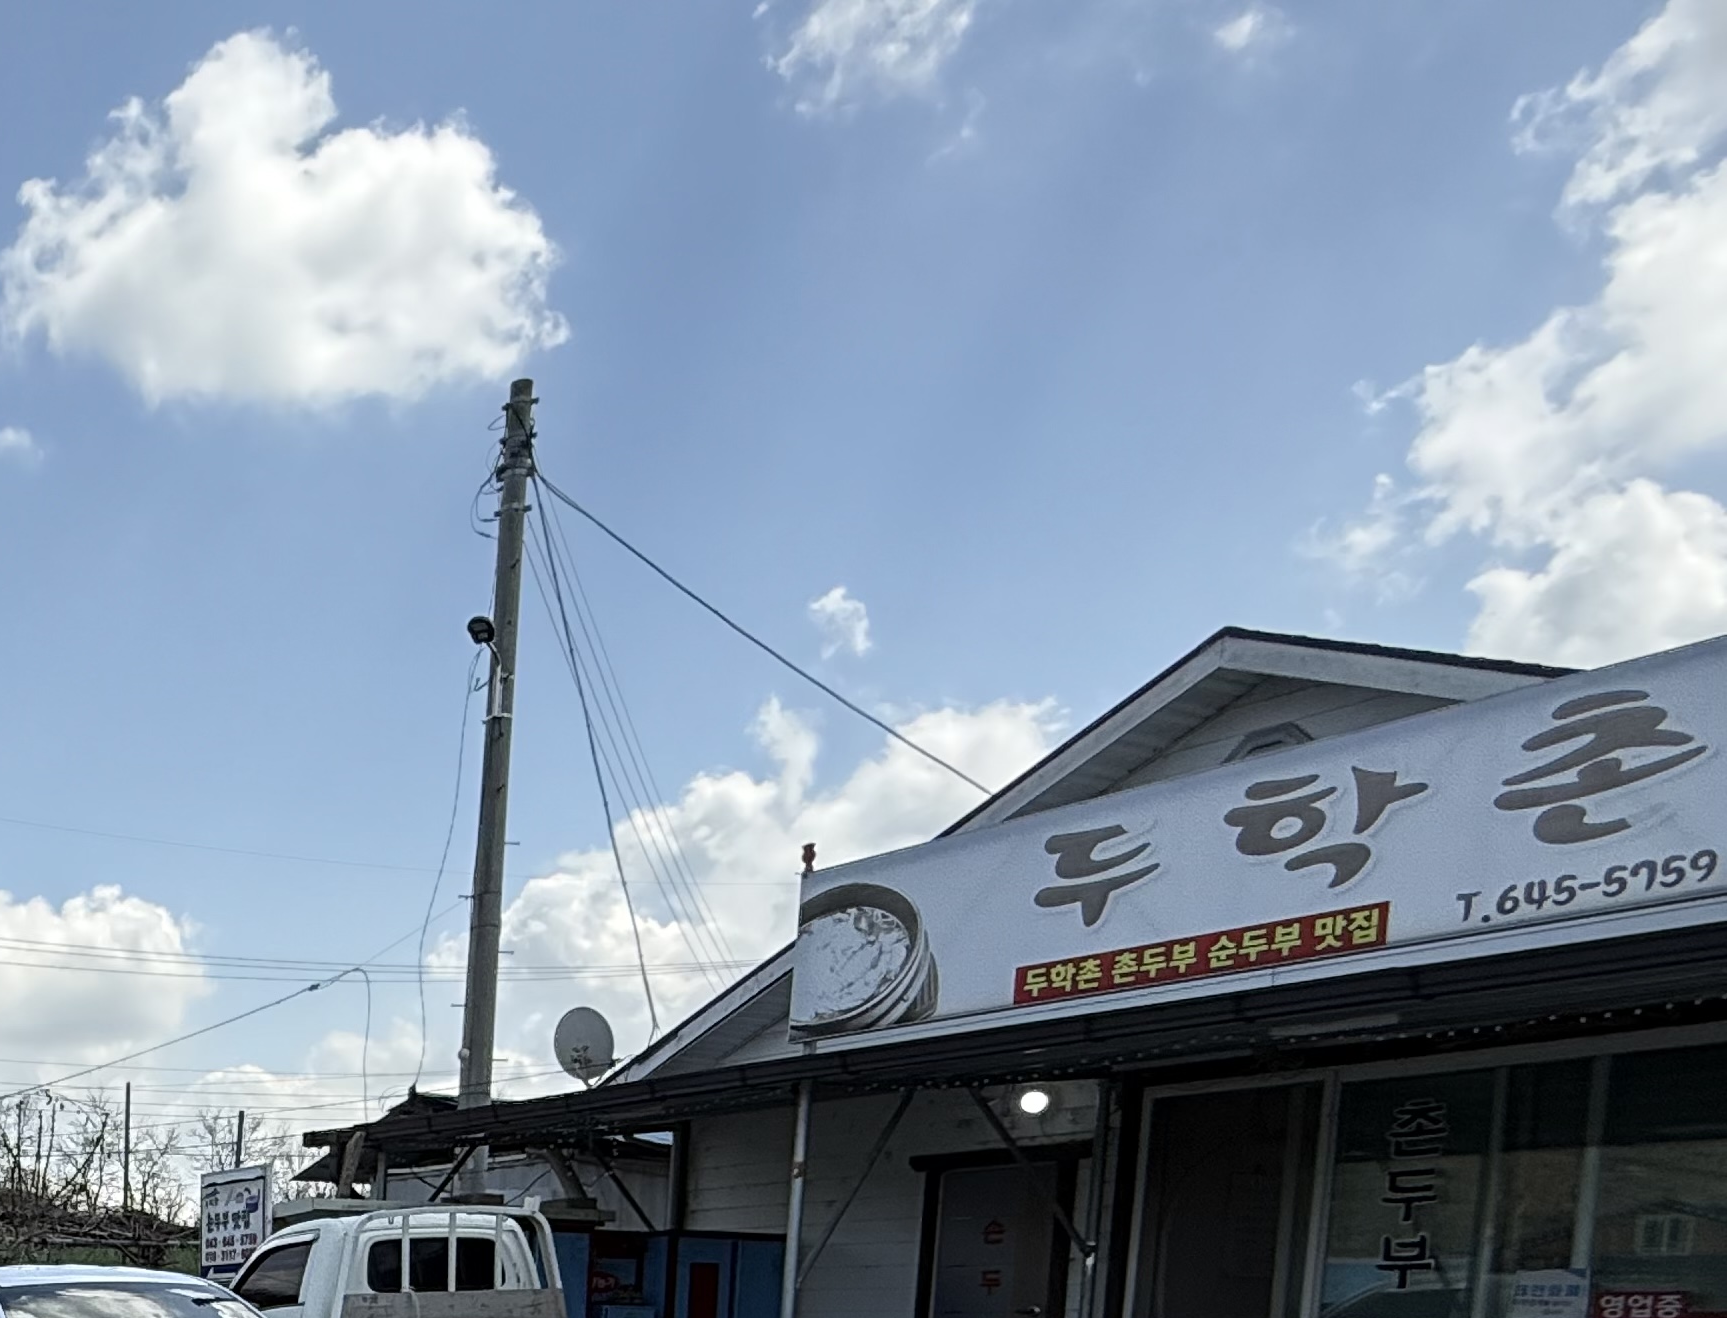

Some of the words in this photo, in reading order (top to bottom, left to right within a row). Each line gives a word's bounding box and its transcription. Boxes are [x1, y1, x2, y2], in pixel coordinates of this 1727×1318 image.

[1034, 689, 1708, 926] 두학촌
[1023, 958, 1101, 997] 두학촌
[1111, 941, 1197, 983] 촌두부
[1207, 923, 1301, 968] 순두부
[1313, 907, 1379, 951] 맛집
[1456, 849, 1718, 923] T.645-5759
[1375, 1099, 1449, 1290] 촌두부
